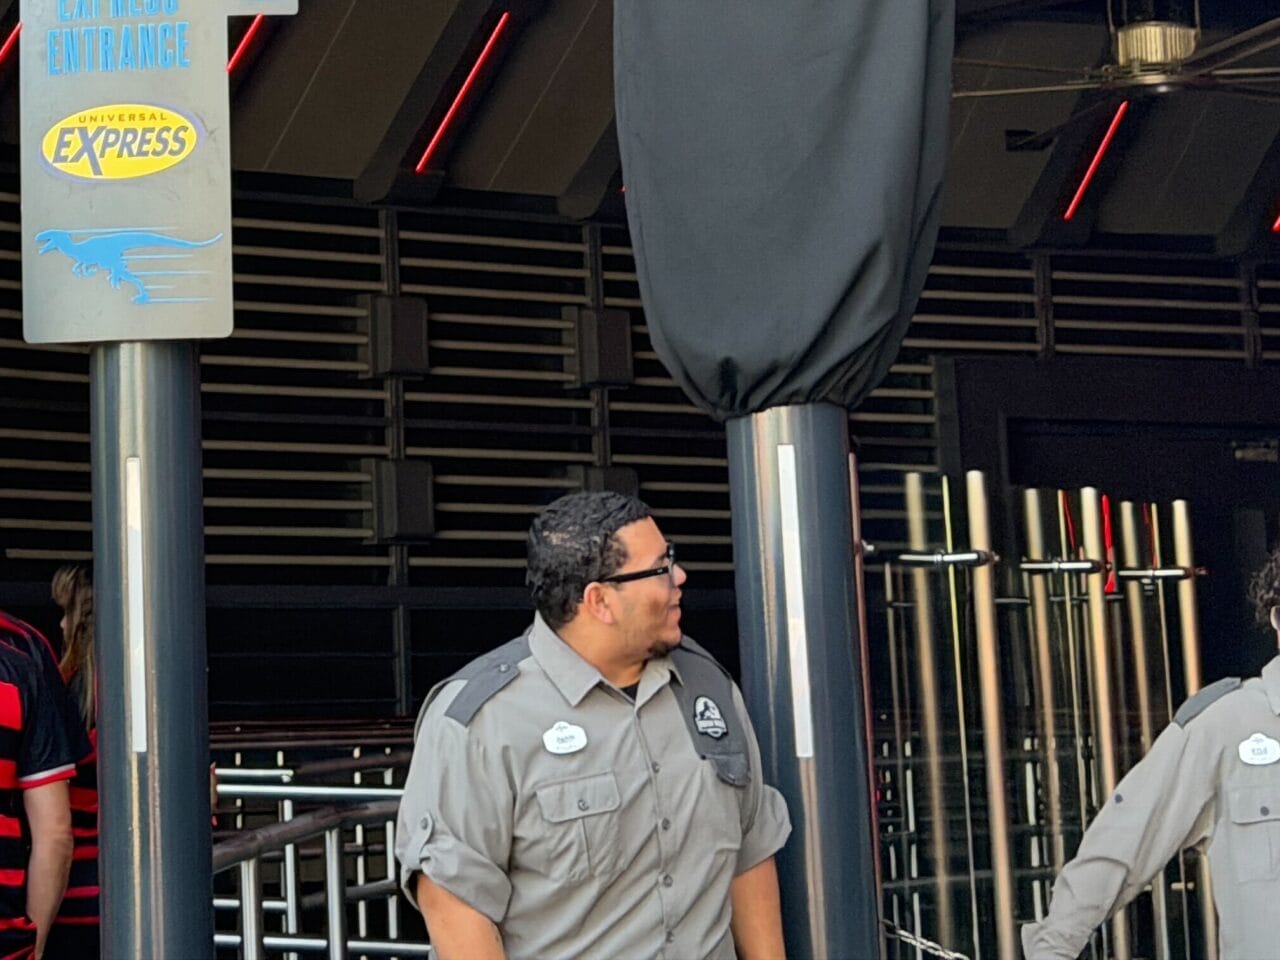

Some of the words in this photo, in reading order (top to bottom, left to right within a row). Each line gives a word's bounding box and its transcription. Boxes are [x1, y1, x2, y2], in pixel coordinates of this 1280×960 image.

[47, 21, 191, 76] ENTRANCE
[78, 112, 168, 124] UNIVERSAL
[52, 125, 189, 176] EXPRESS
